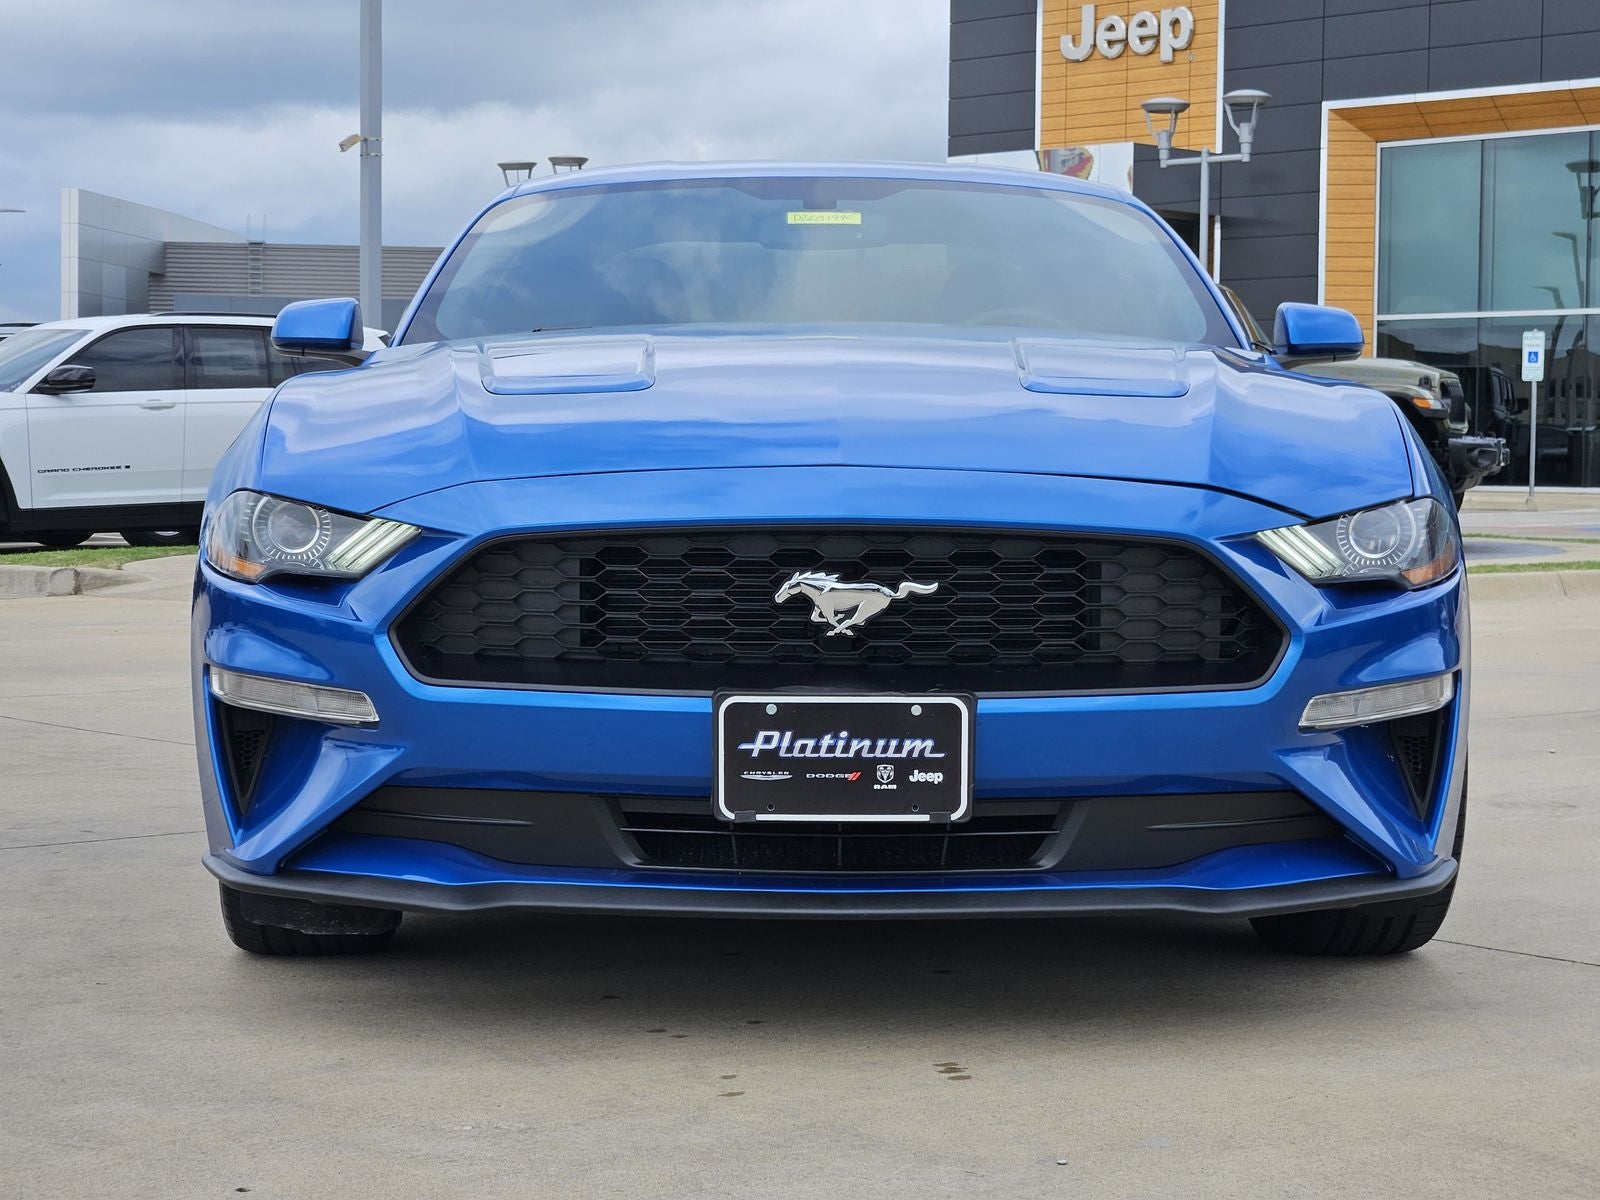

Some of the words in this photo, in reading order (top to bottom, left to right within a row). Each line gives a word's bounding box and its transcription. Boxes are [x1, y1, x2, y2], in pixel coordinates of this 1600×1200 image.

[1059, 3, 1195, 63] Jeep
[737, 731, 944, 757] Platinum
[909, 769, 943, 784] Jeep
